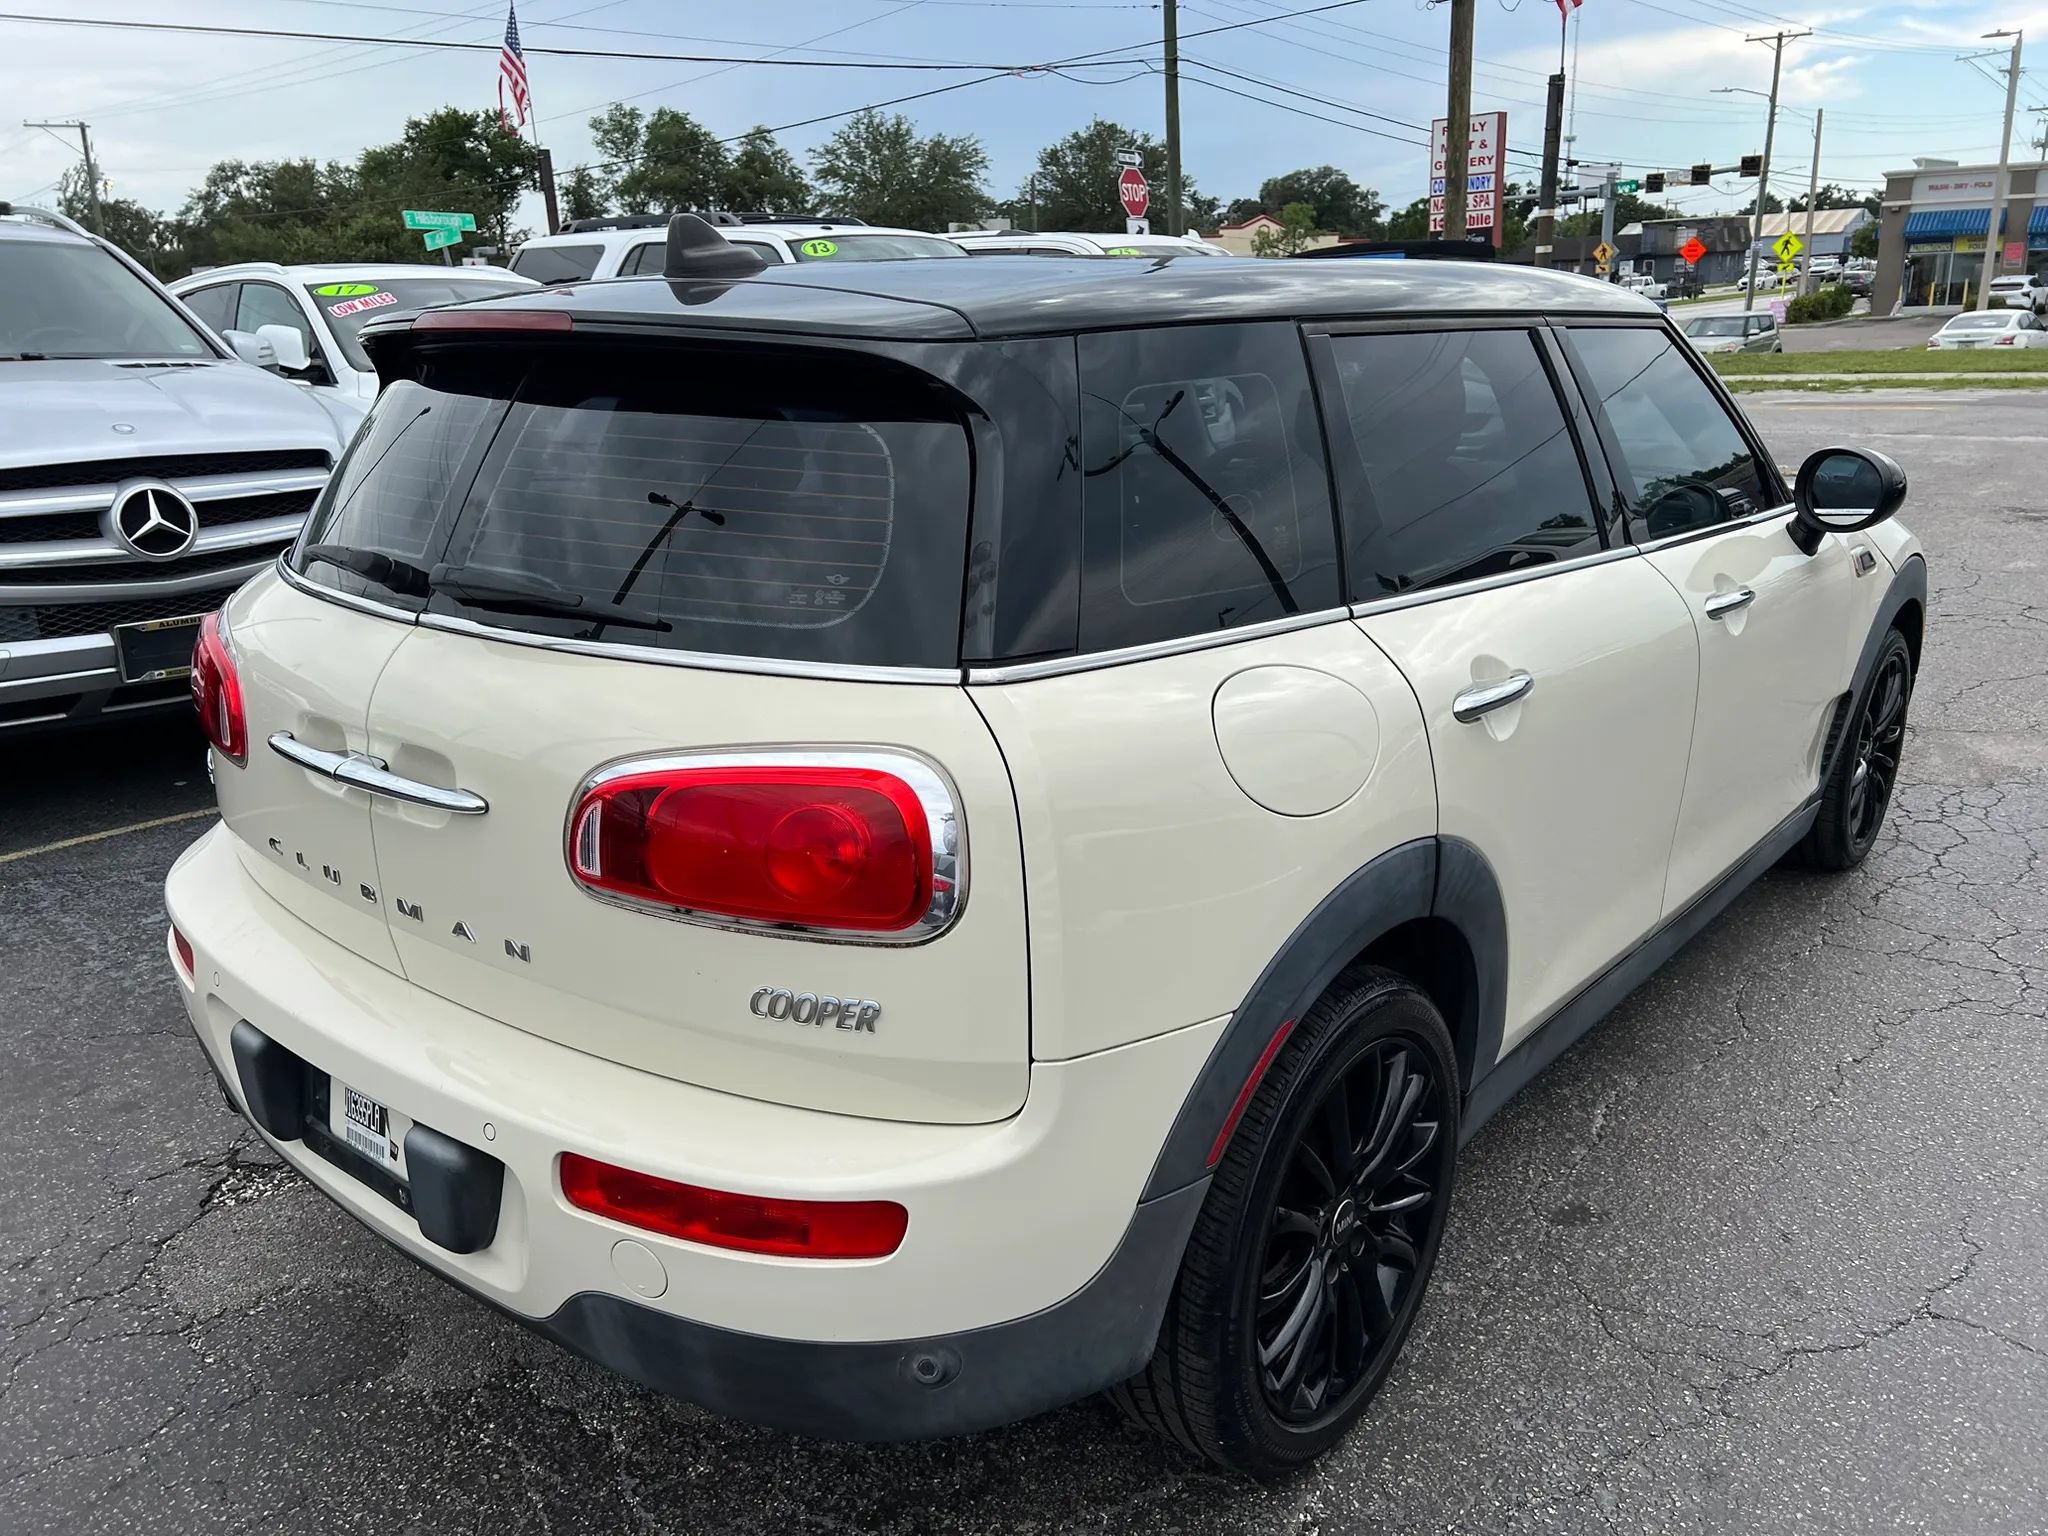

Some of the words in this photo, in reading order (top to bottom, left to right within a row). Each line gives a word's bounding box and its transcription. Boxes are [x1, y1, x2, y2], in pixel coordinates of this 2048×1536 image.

[1442, 121, 1487, 136] FLY
[1441, 140, 1474, 154] MT
[1479, 139, 1488, 150] &
[1434, 155, 1494, 171] GERY
[1122, 182, 1146, 202] STOP
[1472, 194, 1490, 208] SPA
[810, 242, 830, 254] 13
[335, 285, 358, 295] 17
[330, 301, 359, 316] LOW
[359, 293, 396, 310] MILES
[268, 836, 531, 964] CLUBMAN
[749, 985, 882, 1034] COOPER
